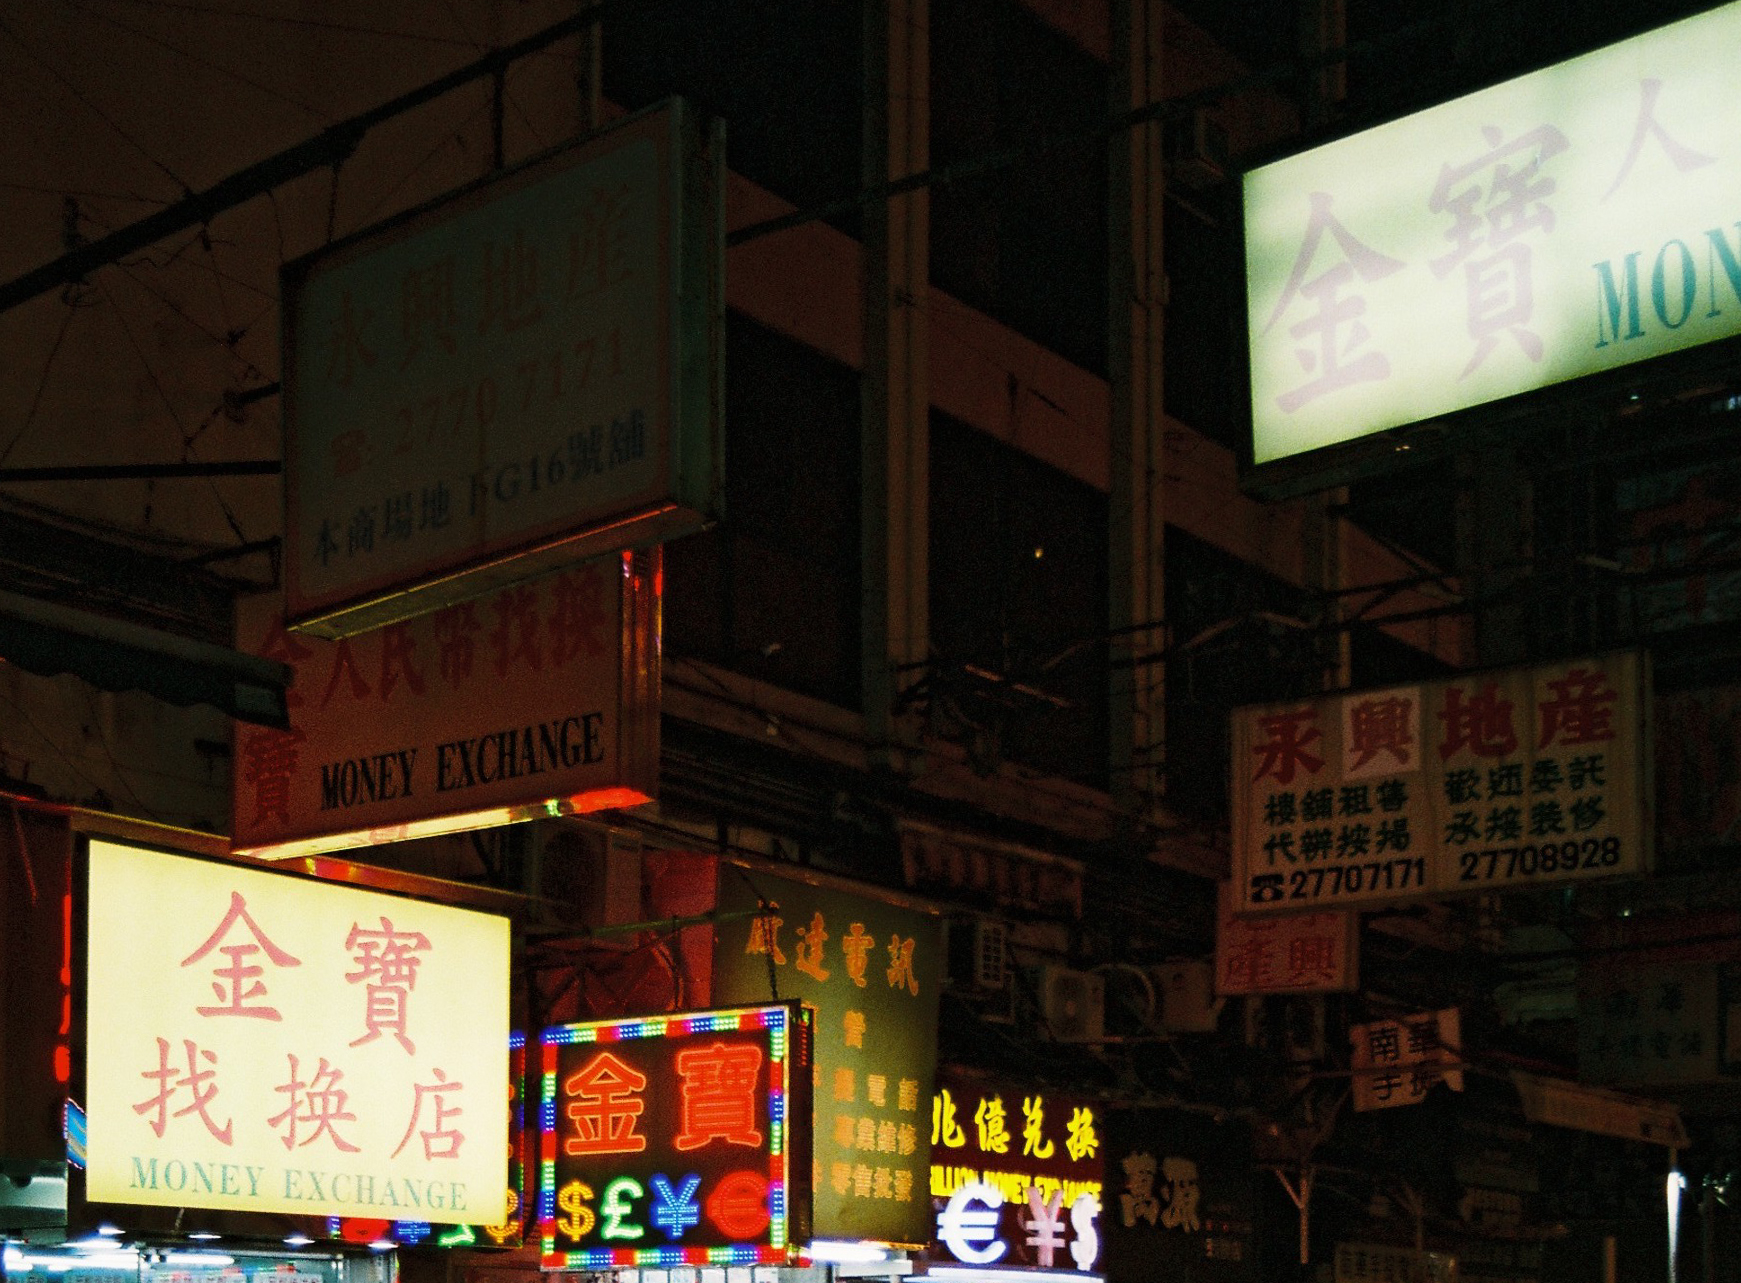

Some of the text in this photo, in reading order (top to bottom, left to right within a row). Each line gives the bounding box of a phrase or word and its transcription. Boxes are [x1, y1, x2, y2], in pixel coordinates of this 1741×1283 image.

[395, 327, 622, 456] 2770 7171
[321, 713, 603, 811] MONEY EXCHANGE
[1292, 838, 1619, 899] 27707171 27708928
[180, 891, 432, 1056] 金寶
[565, 1043, 762, 1155] 金寶
[130, 1157, 467, 1211] MONEY EXCHANGE
